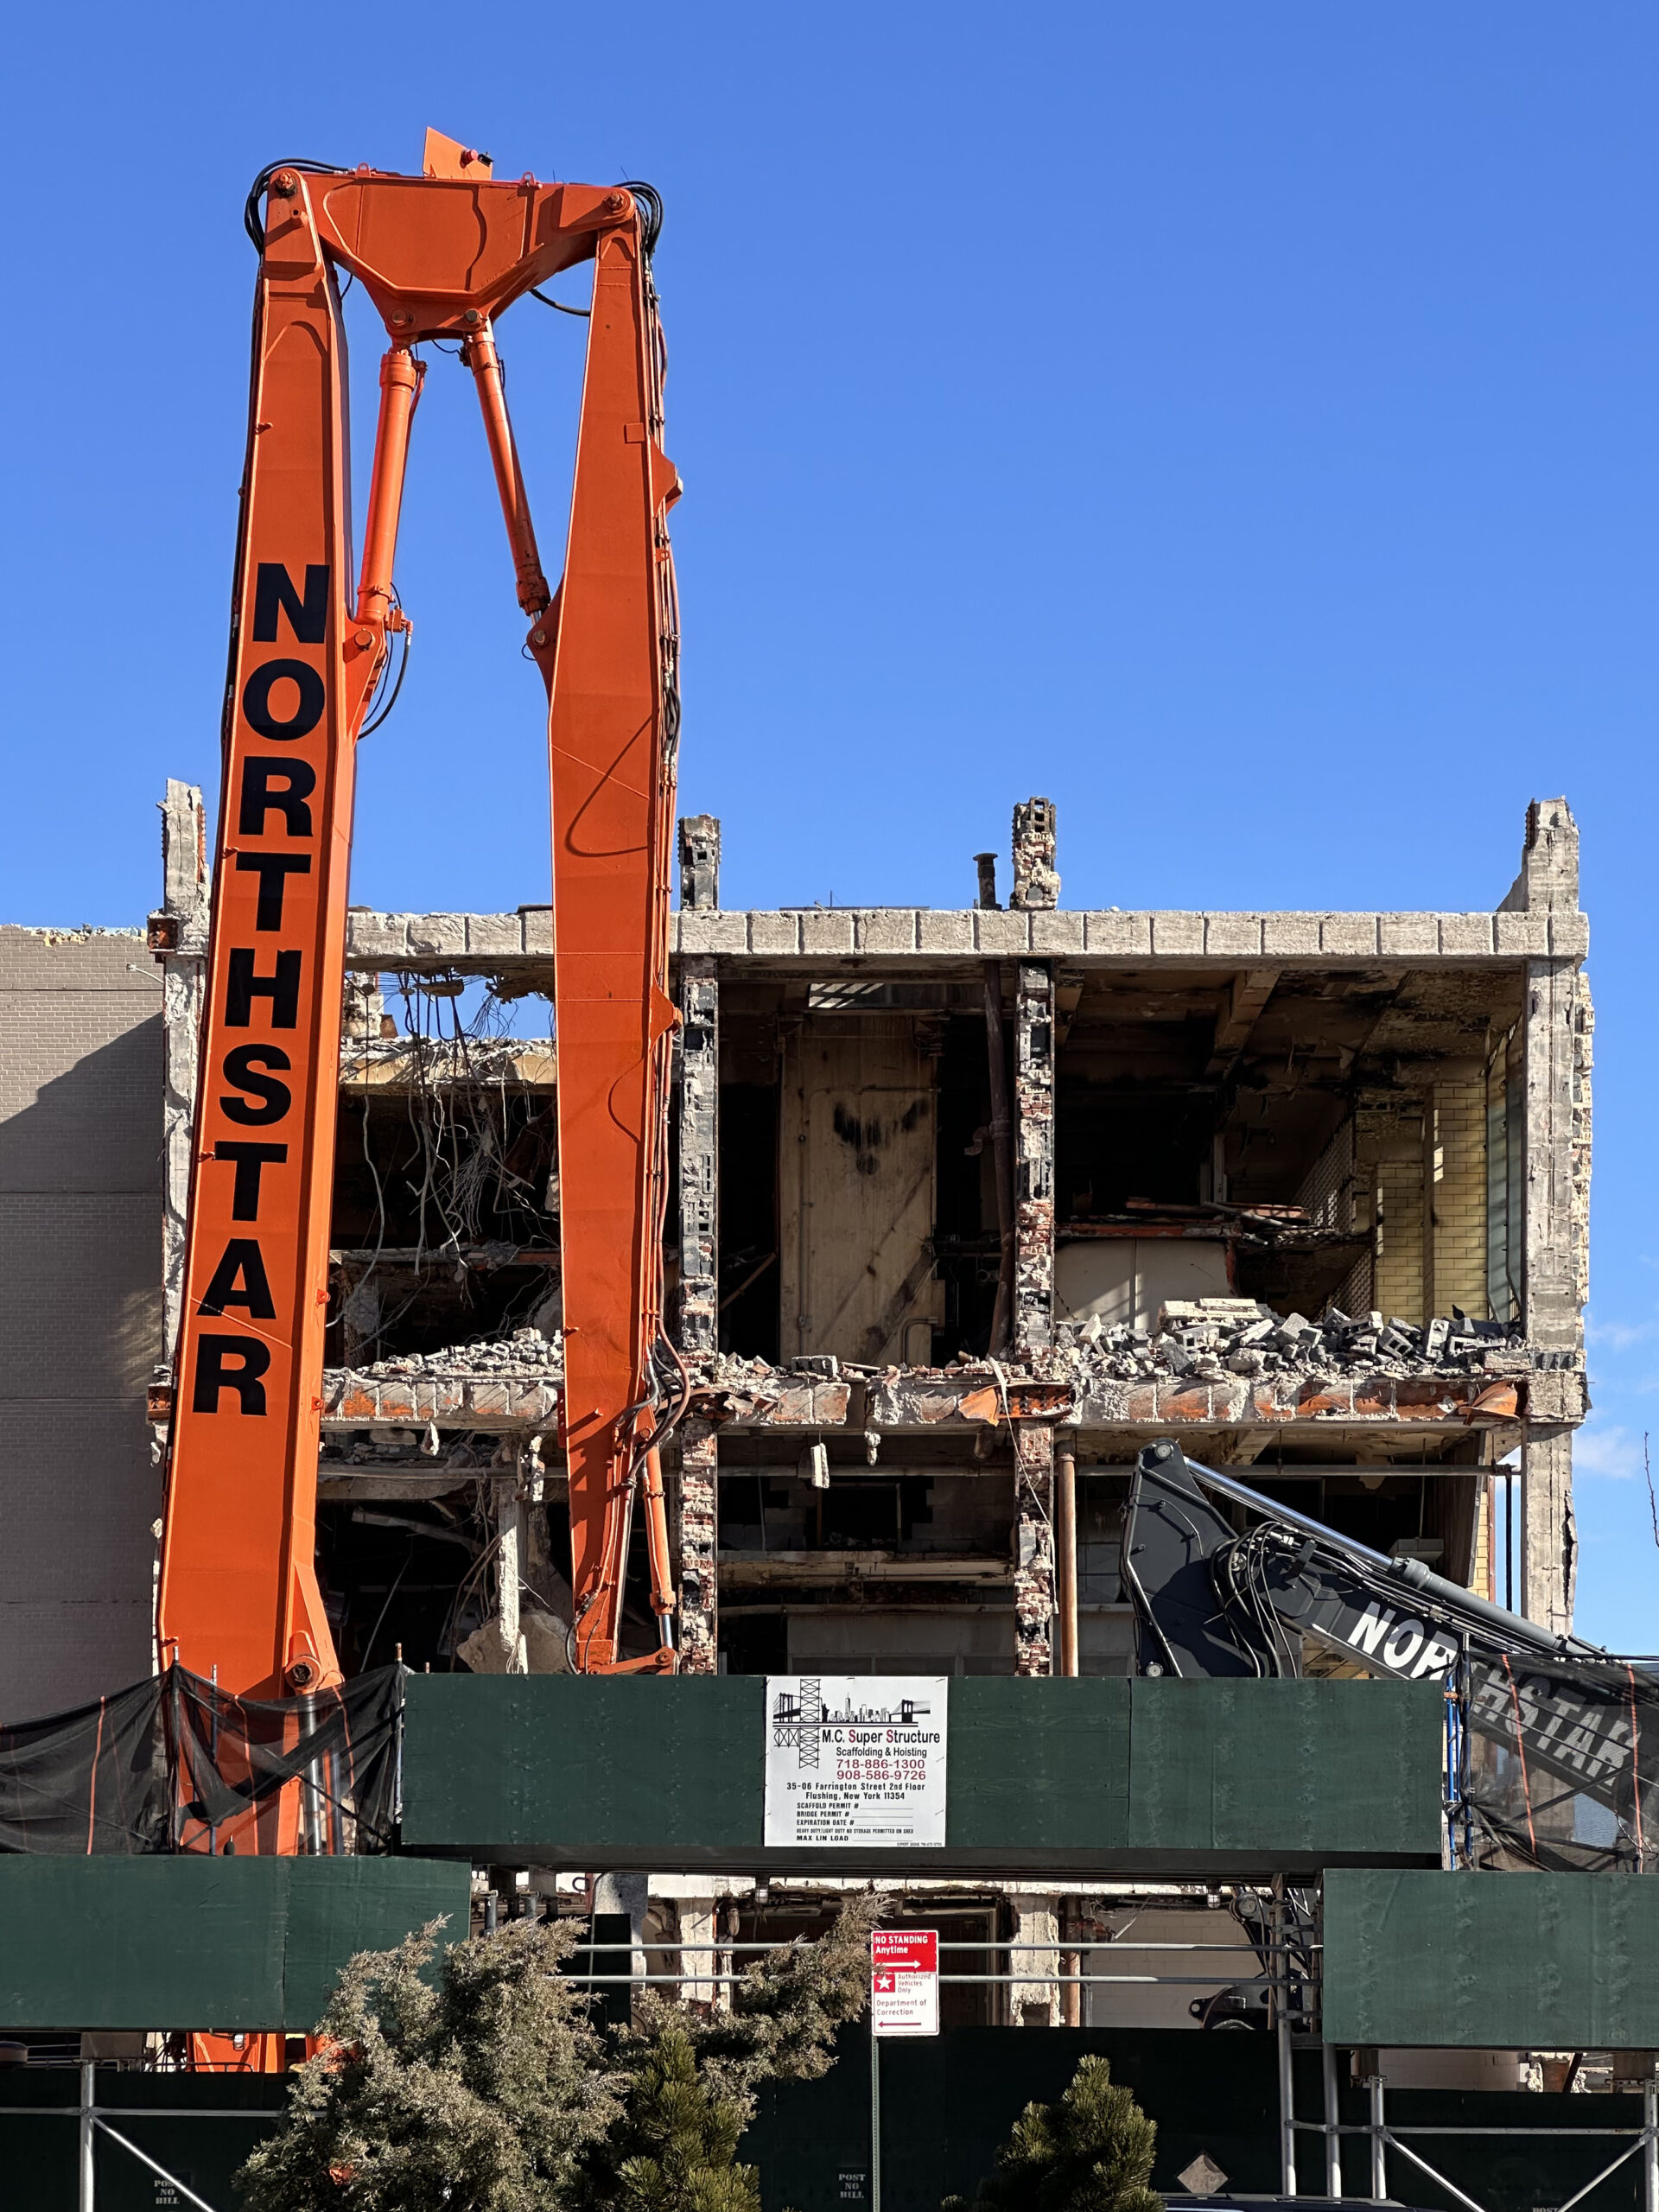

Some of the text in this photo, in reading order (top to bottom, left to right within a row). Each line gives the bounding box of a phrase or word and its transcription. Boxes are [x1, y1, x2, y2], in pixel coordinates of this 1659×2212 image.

[193, 563, 330, 1416] NORTHSTAR
[822, 1729, 940, 1746] M.C. Super Structure
[836, 1747, 927, 1758] Scaffolding & Hoisting
[836, 1759, 925, 1769] 718-886-1300
[836, 1770, 926, 1780] 908-586-9726
[816, 1782, 857, 1791] Farrington
[805, 1792, 841, 1801] Flushing,
[875, 1936, 928, 1944] NO STANDING
[875, 1946, 908, 1955] Anytime
